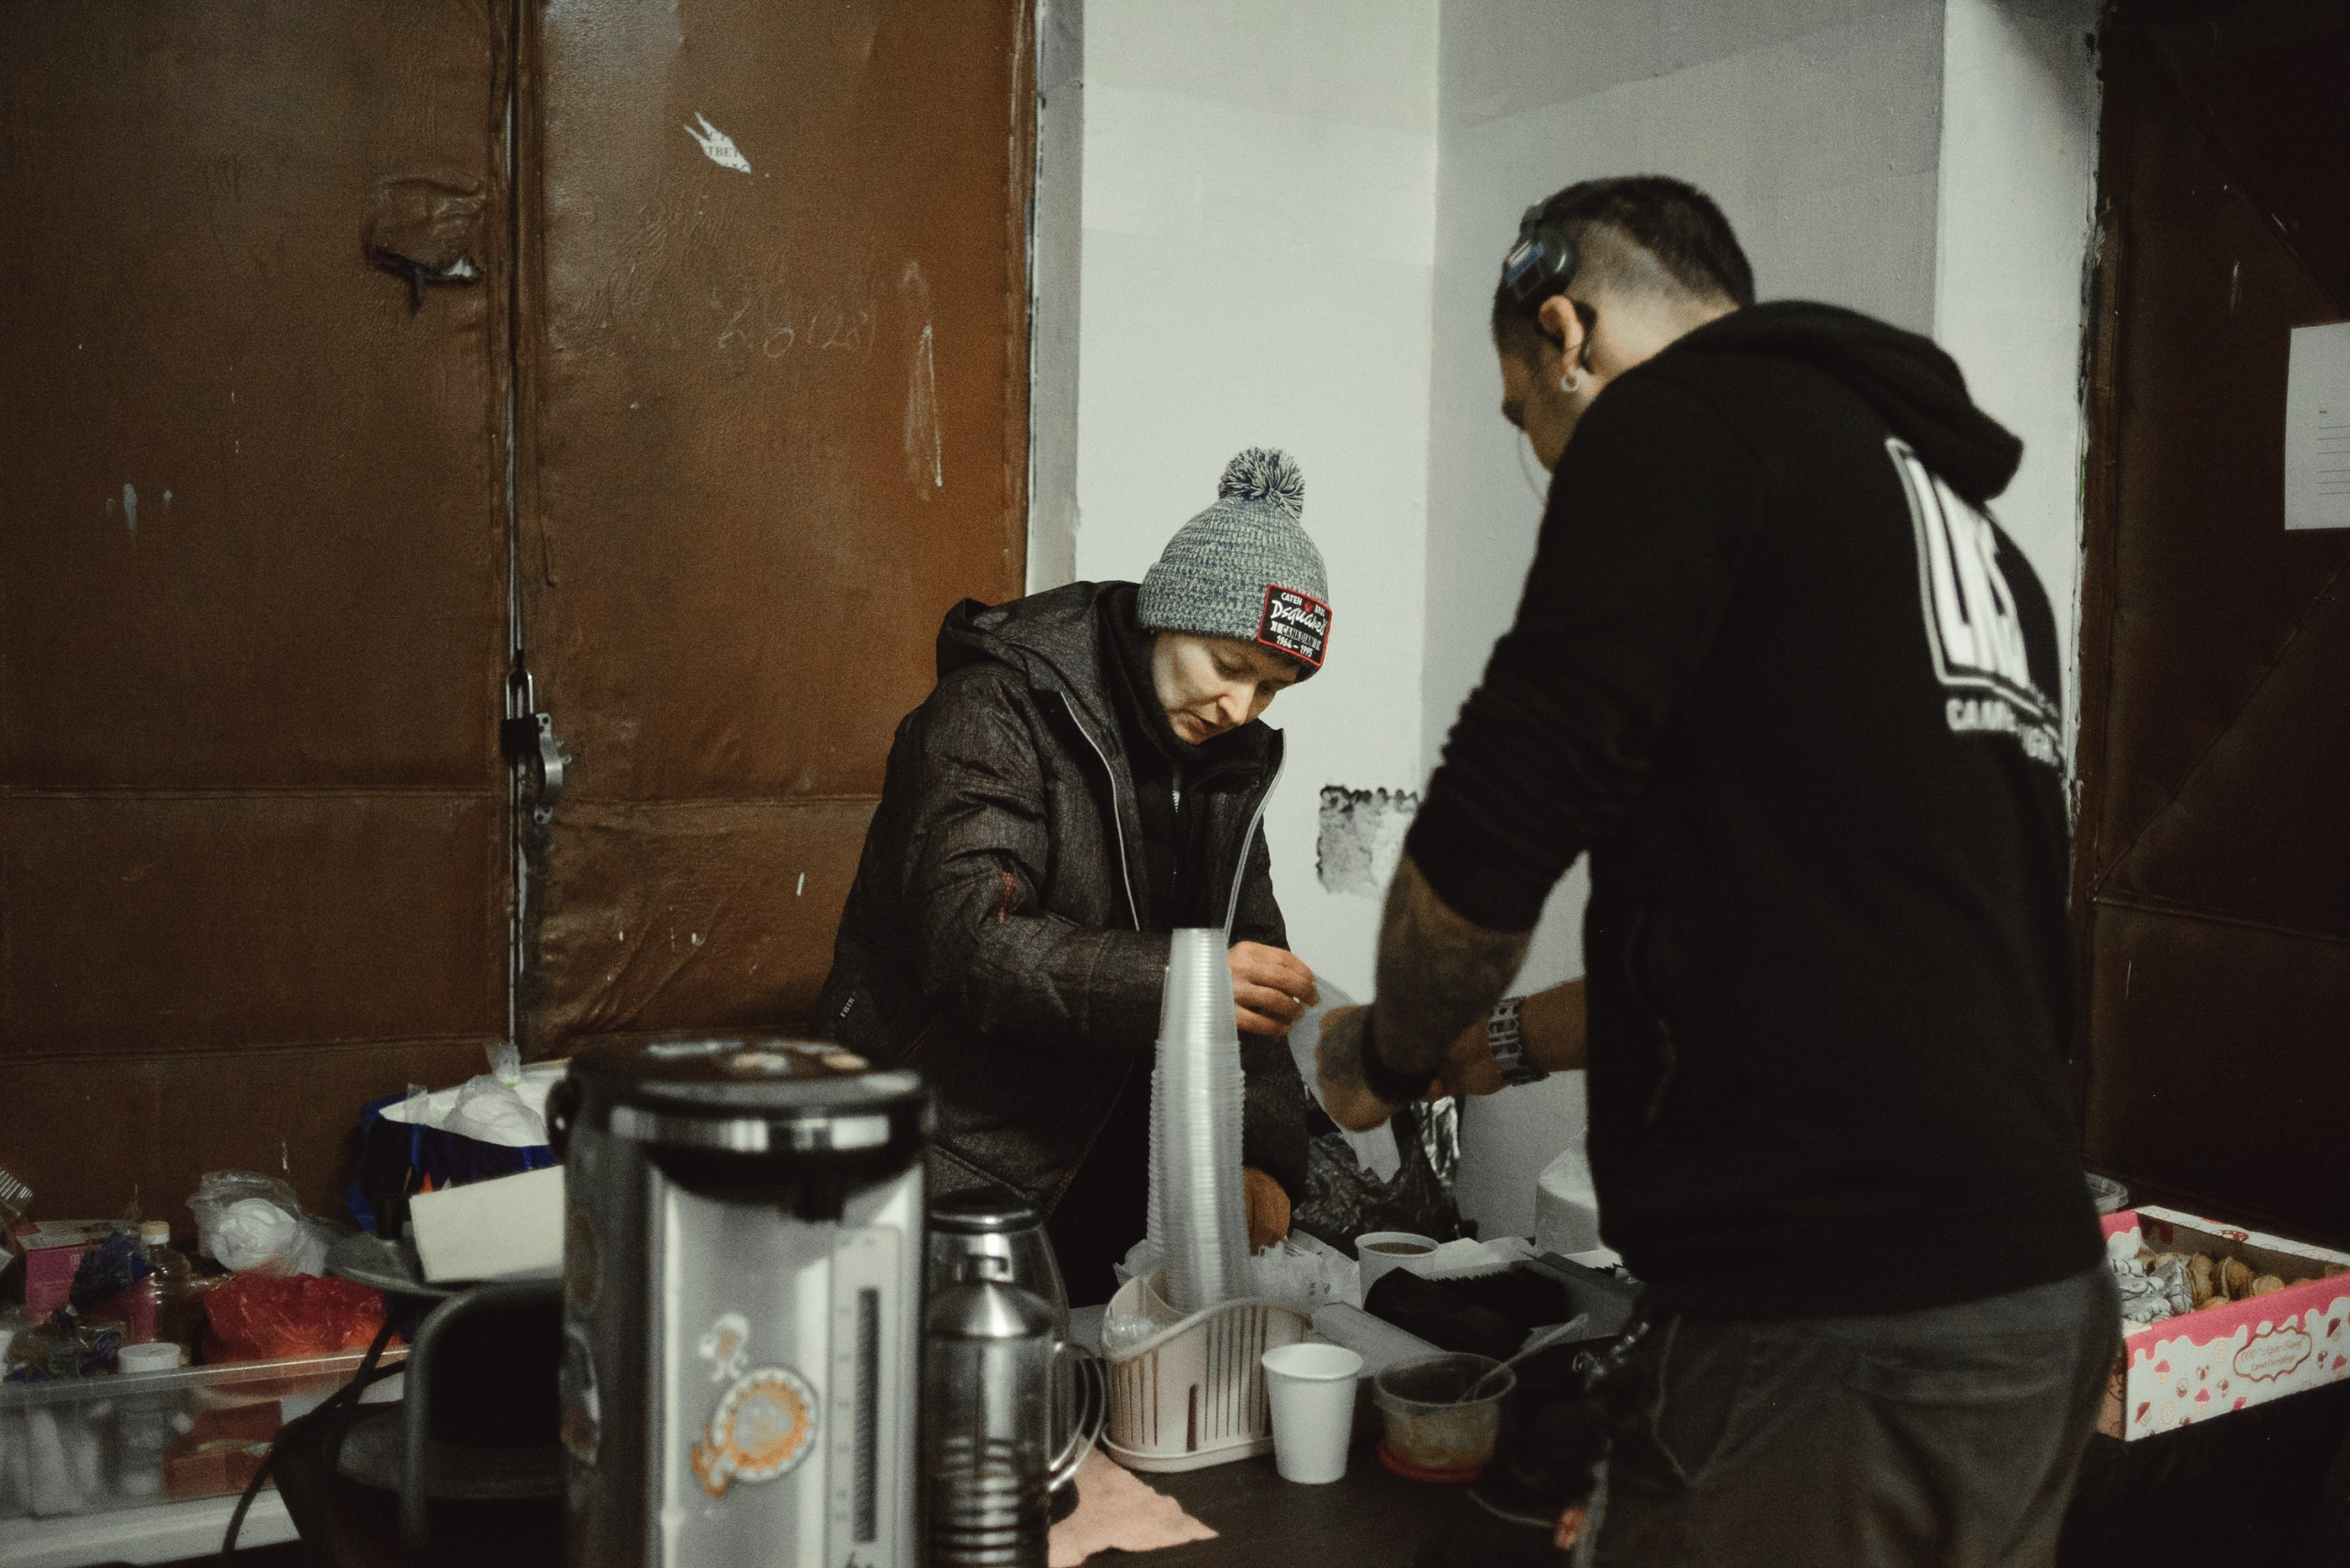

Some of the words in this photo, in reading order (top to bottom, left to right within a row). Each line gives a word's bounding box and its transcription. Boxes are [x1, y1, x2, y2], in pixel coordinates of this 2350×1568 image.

[1281, 592, 1303, 606] CATEN
[1277, 635, 1292, 648] 1964
[1300, 644, 1313, 657] 1995
